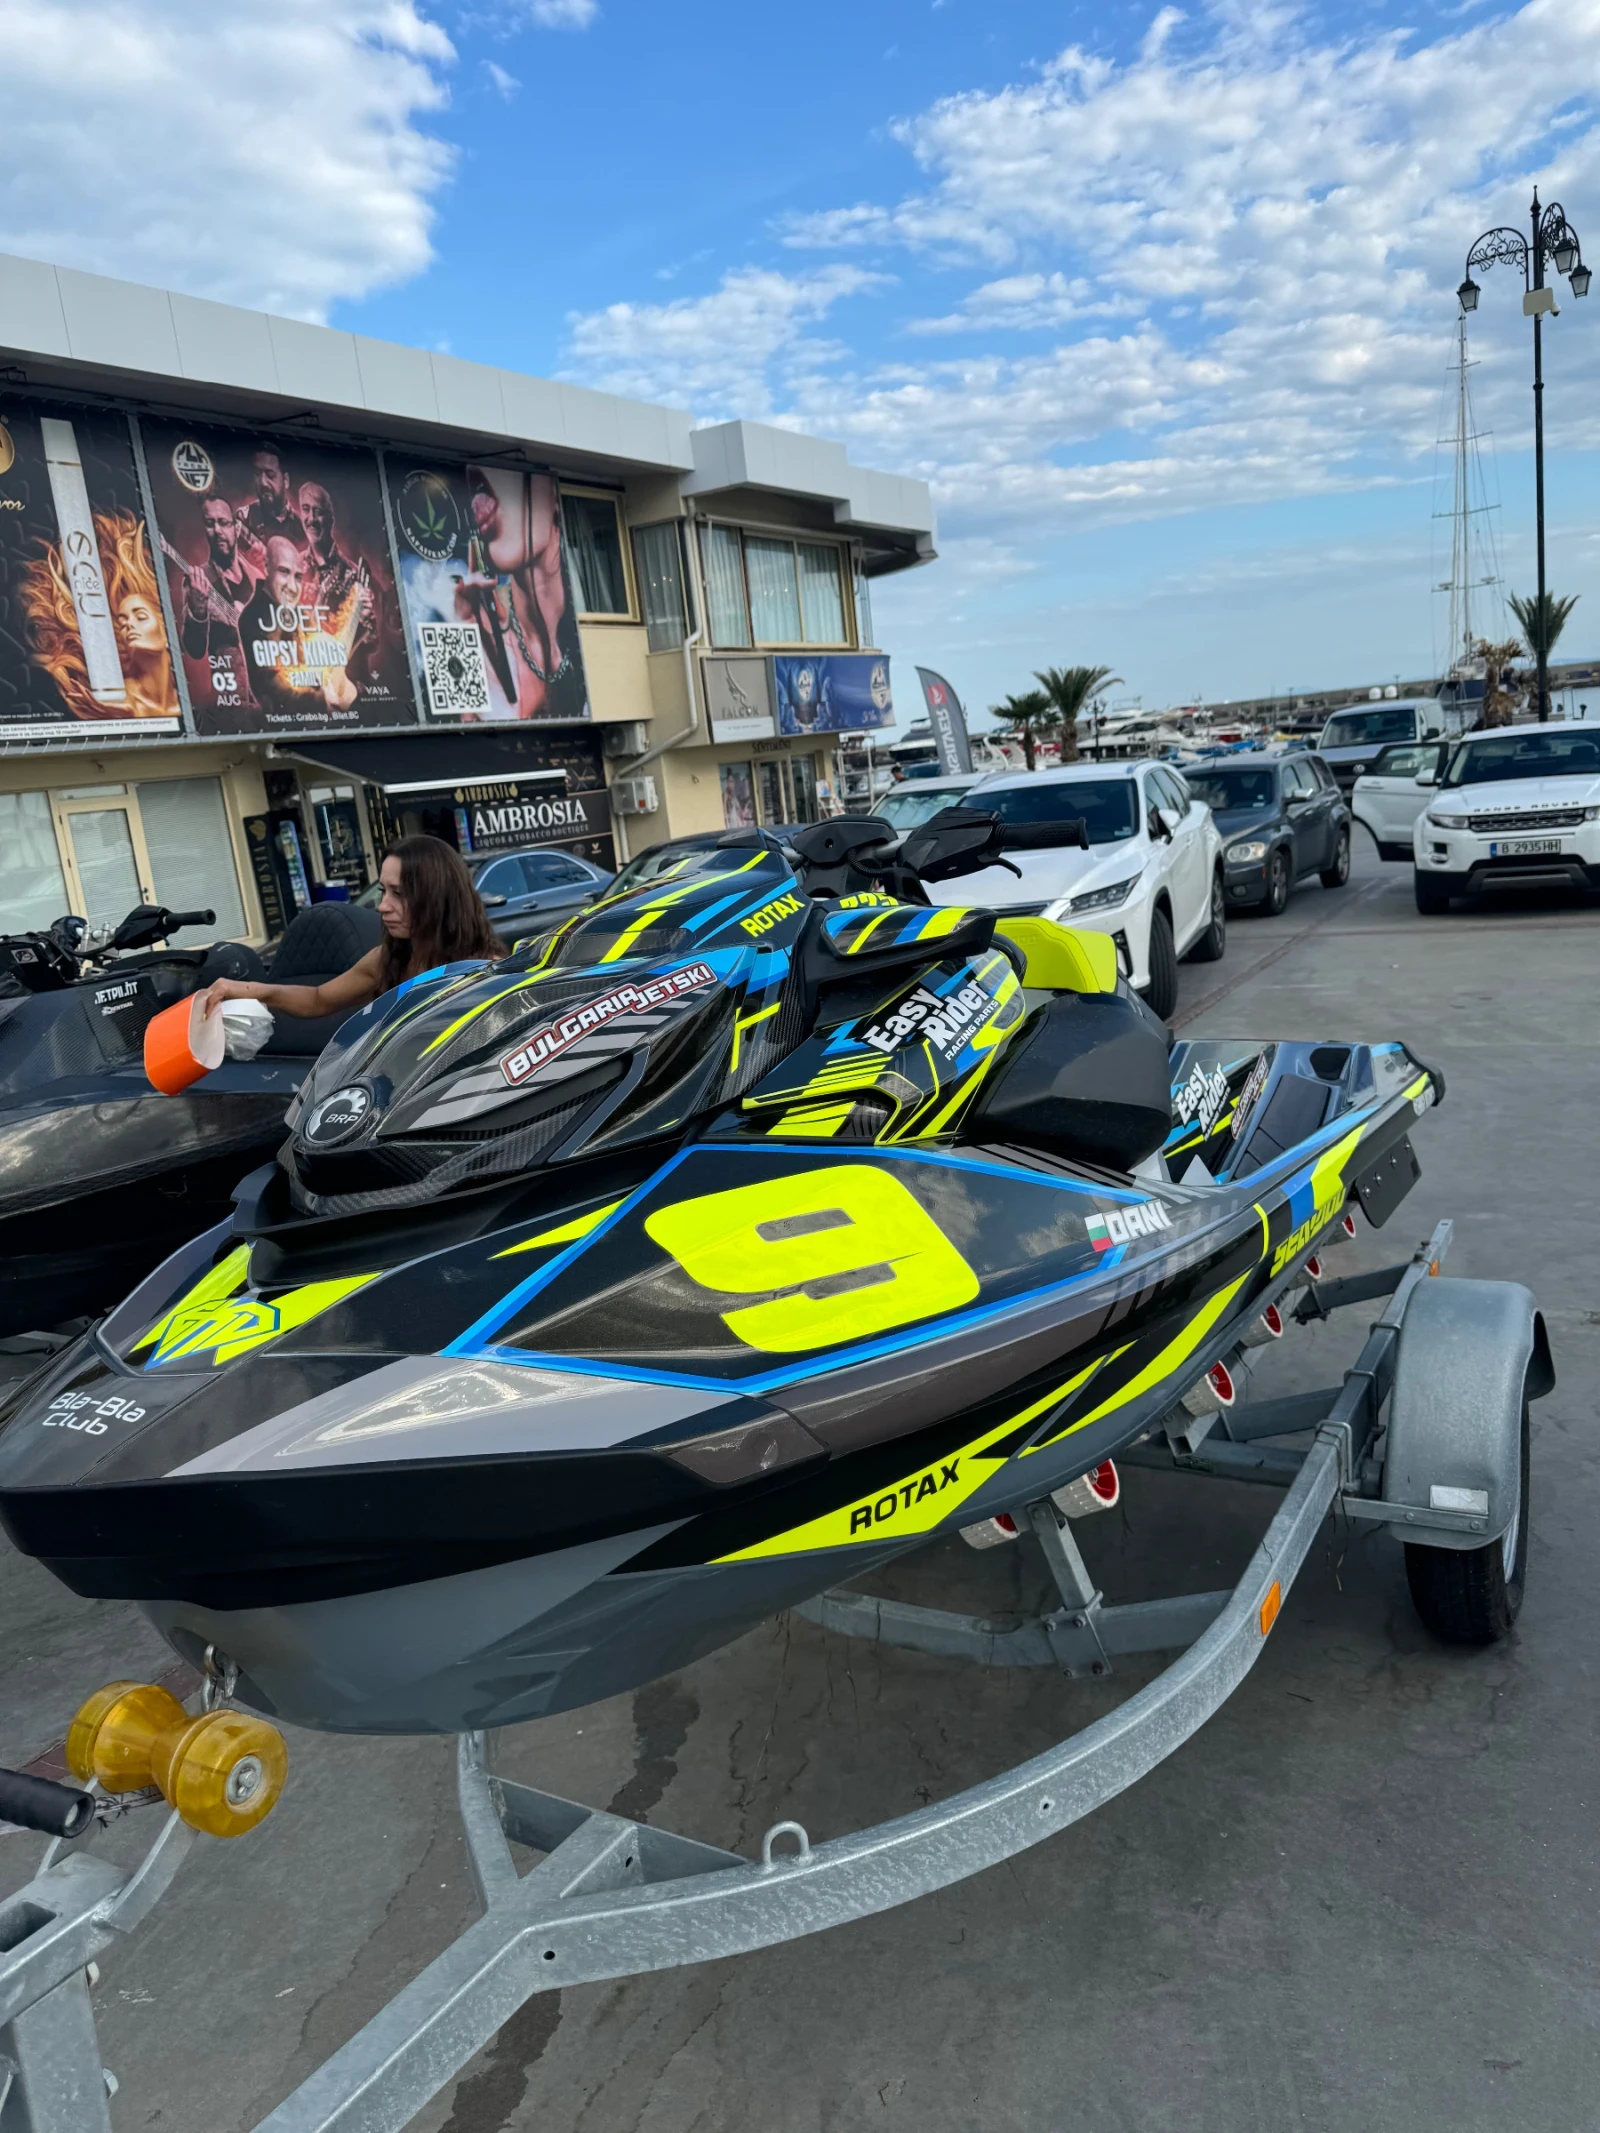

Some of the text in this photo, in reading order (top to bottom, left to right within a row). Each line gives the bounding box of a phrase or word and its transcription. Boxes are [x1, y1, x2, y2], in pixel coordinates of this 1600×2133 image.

[258, 603, 330, 632] JOEF
[208, 655, 233, 670] SAT
[252, 640, 348, 667] GIPSY KINGS
[212, 672, 238, 692] 03
[289, 671, 323, 687] FAMILY
[365, 685, 390, 696] VAYA
[217, 694, 242, 707] AUG
[721, 705, 760, 719] FALCON
[474, 799, 588, 837] AMBROSIA
[474, 834, 506, 849] LIQUOR
[516, 826, 551, 842] TOBACCO
[552, 823, 589, 836] BOUTIQUE
[1502, 843, 1510, 854] B
[739, 893, 806, 938] ROTAX
[94, 981, 138, 1005] JETPILOT
[507, 965, 711, 1080] BULGARIA JETSKI
[861, 987, 945, 1053] Easy
[917, 979, 990, 1051] Rider
[944, 999, 999, 1061] RACING PARTS
[1175, 1061, 1210, 1126] Easy
[1197, 1062, 1228, 1134] Rider
[324, 1113, 359, 1124] BRP
[1103, 1200, 1174, 1245] DANI
[644, 1164, 981, 1353] 9
[48, 1391, 146, 1422] Bla-Bla
[42, 1411, 109, 1435] Club
[850, 1457, 960, 1536] ROTAX
